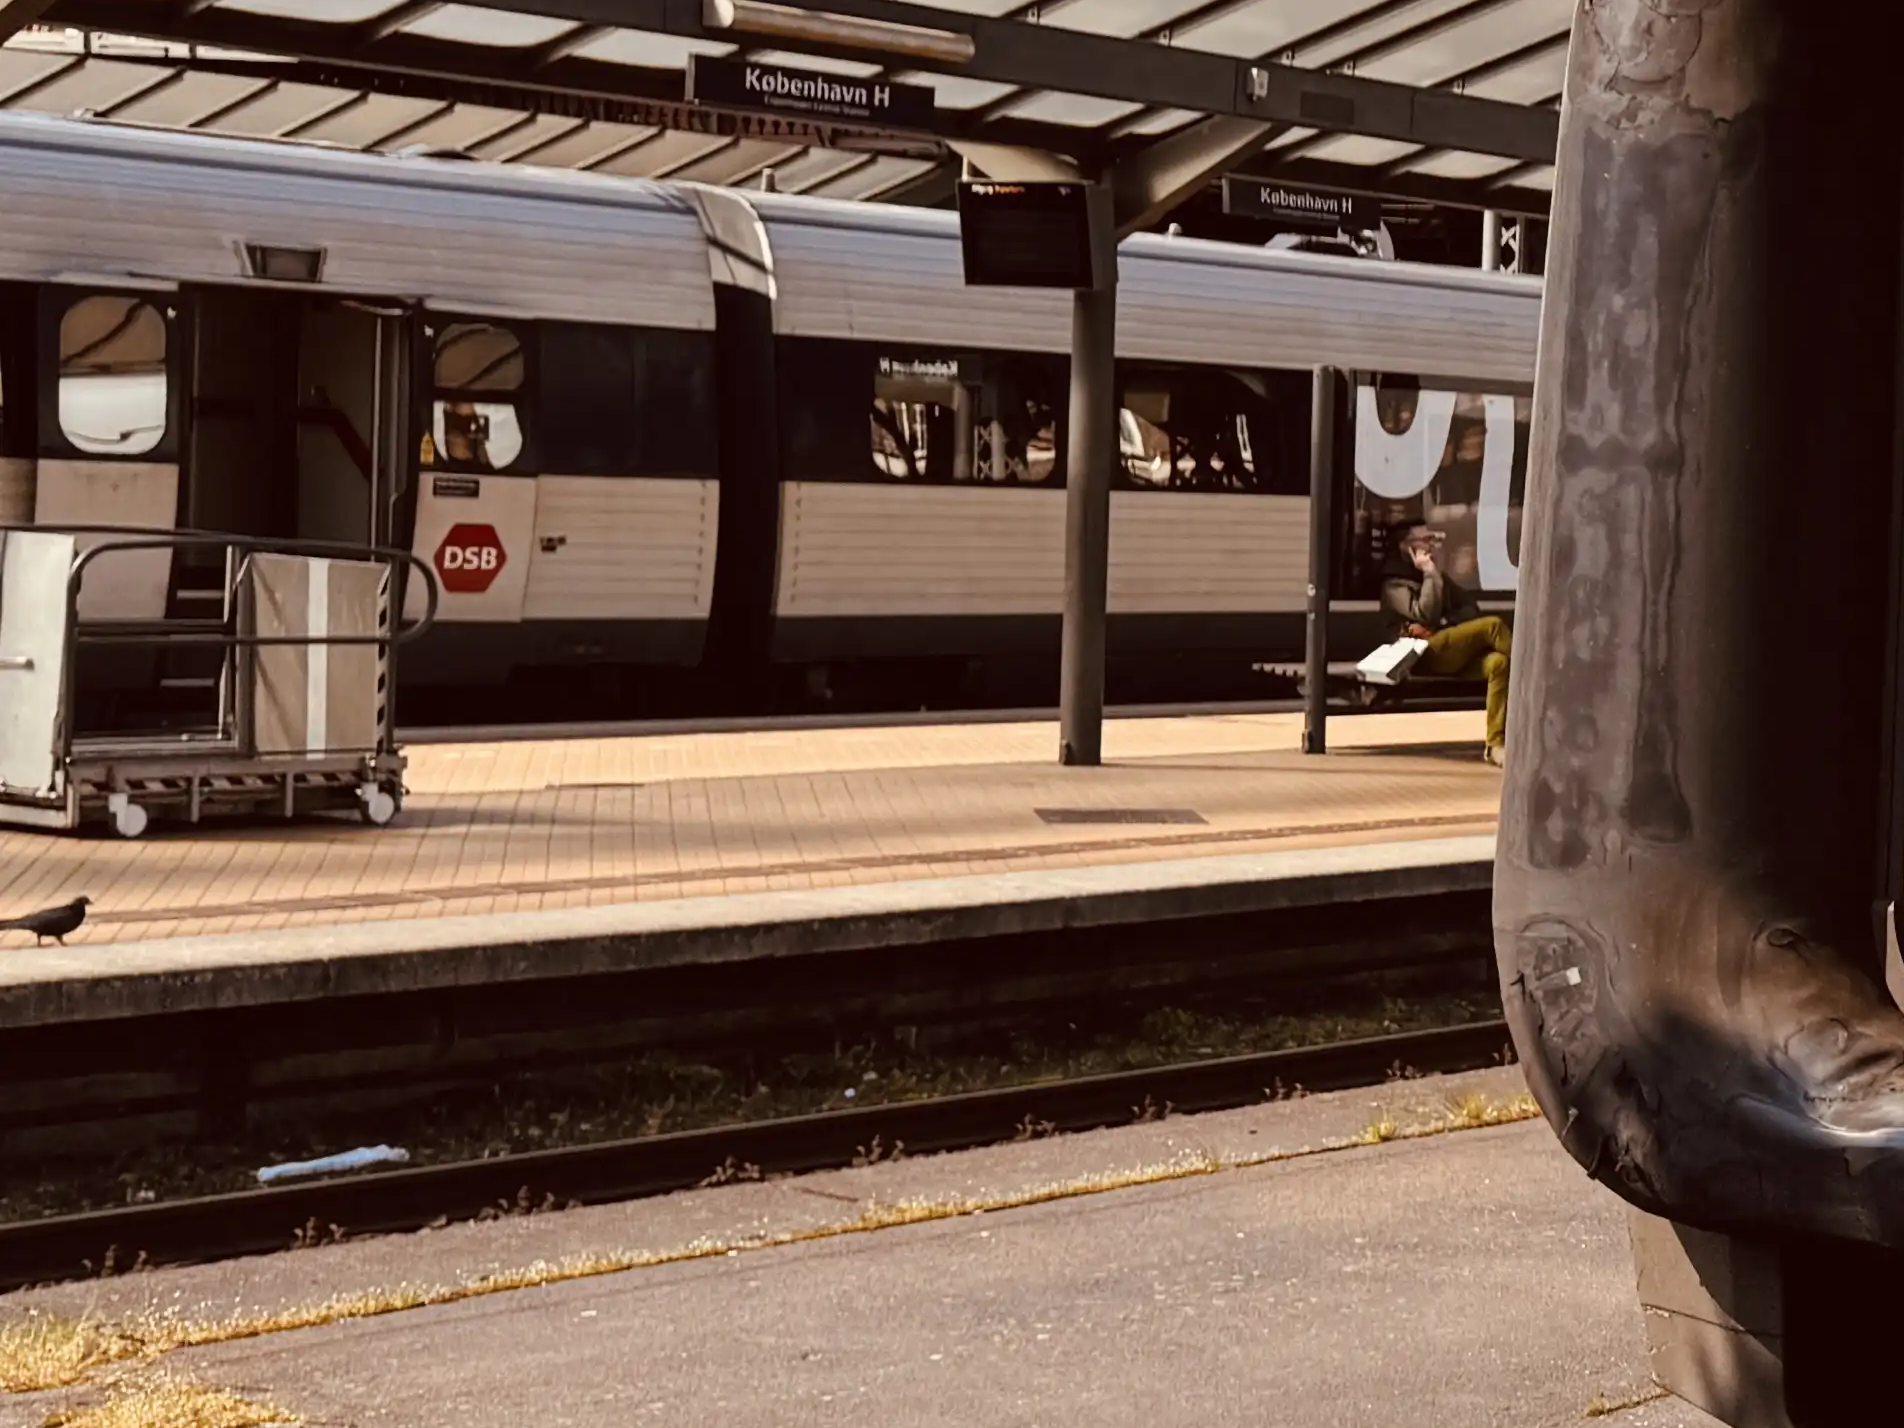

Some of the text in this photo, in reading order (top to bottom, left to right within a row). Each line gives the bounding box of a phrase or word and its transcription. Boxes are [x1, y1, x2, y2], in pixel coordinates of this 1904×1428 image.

[745, 67, 867, 105] København
[874, 84, 890, 108] H
[1260, 187, 1338, 212] København
[1342, 197, 1352, 214] H
[443, 546, 498, 570] DSB
